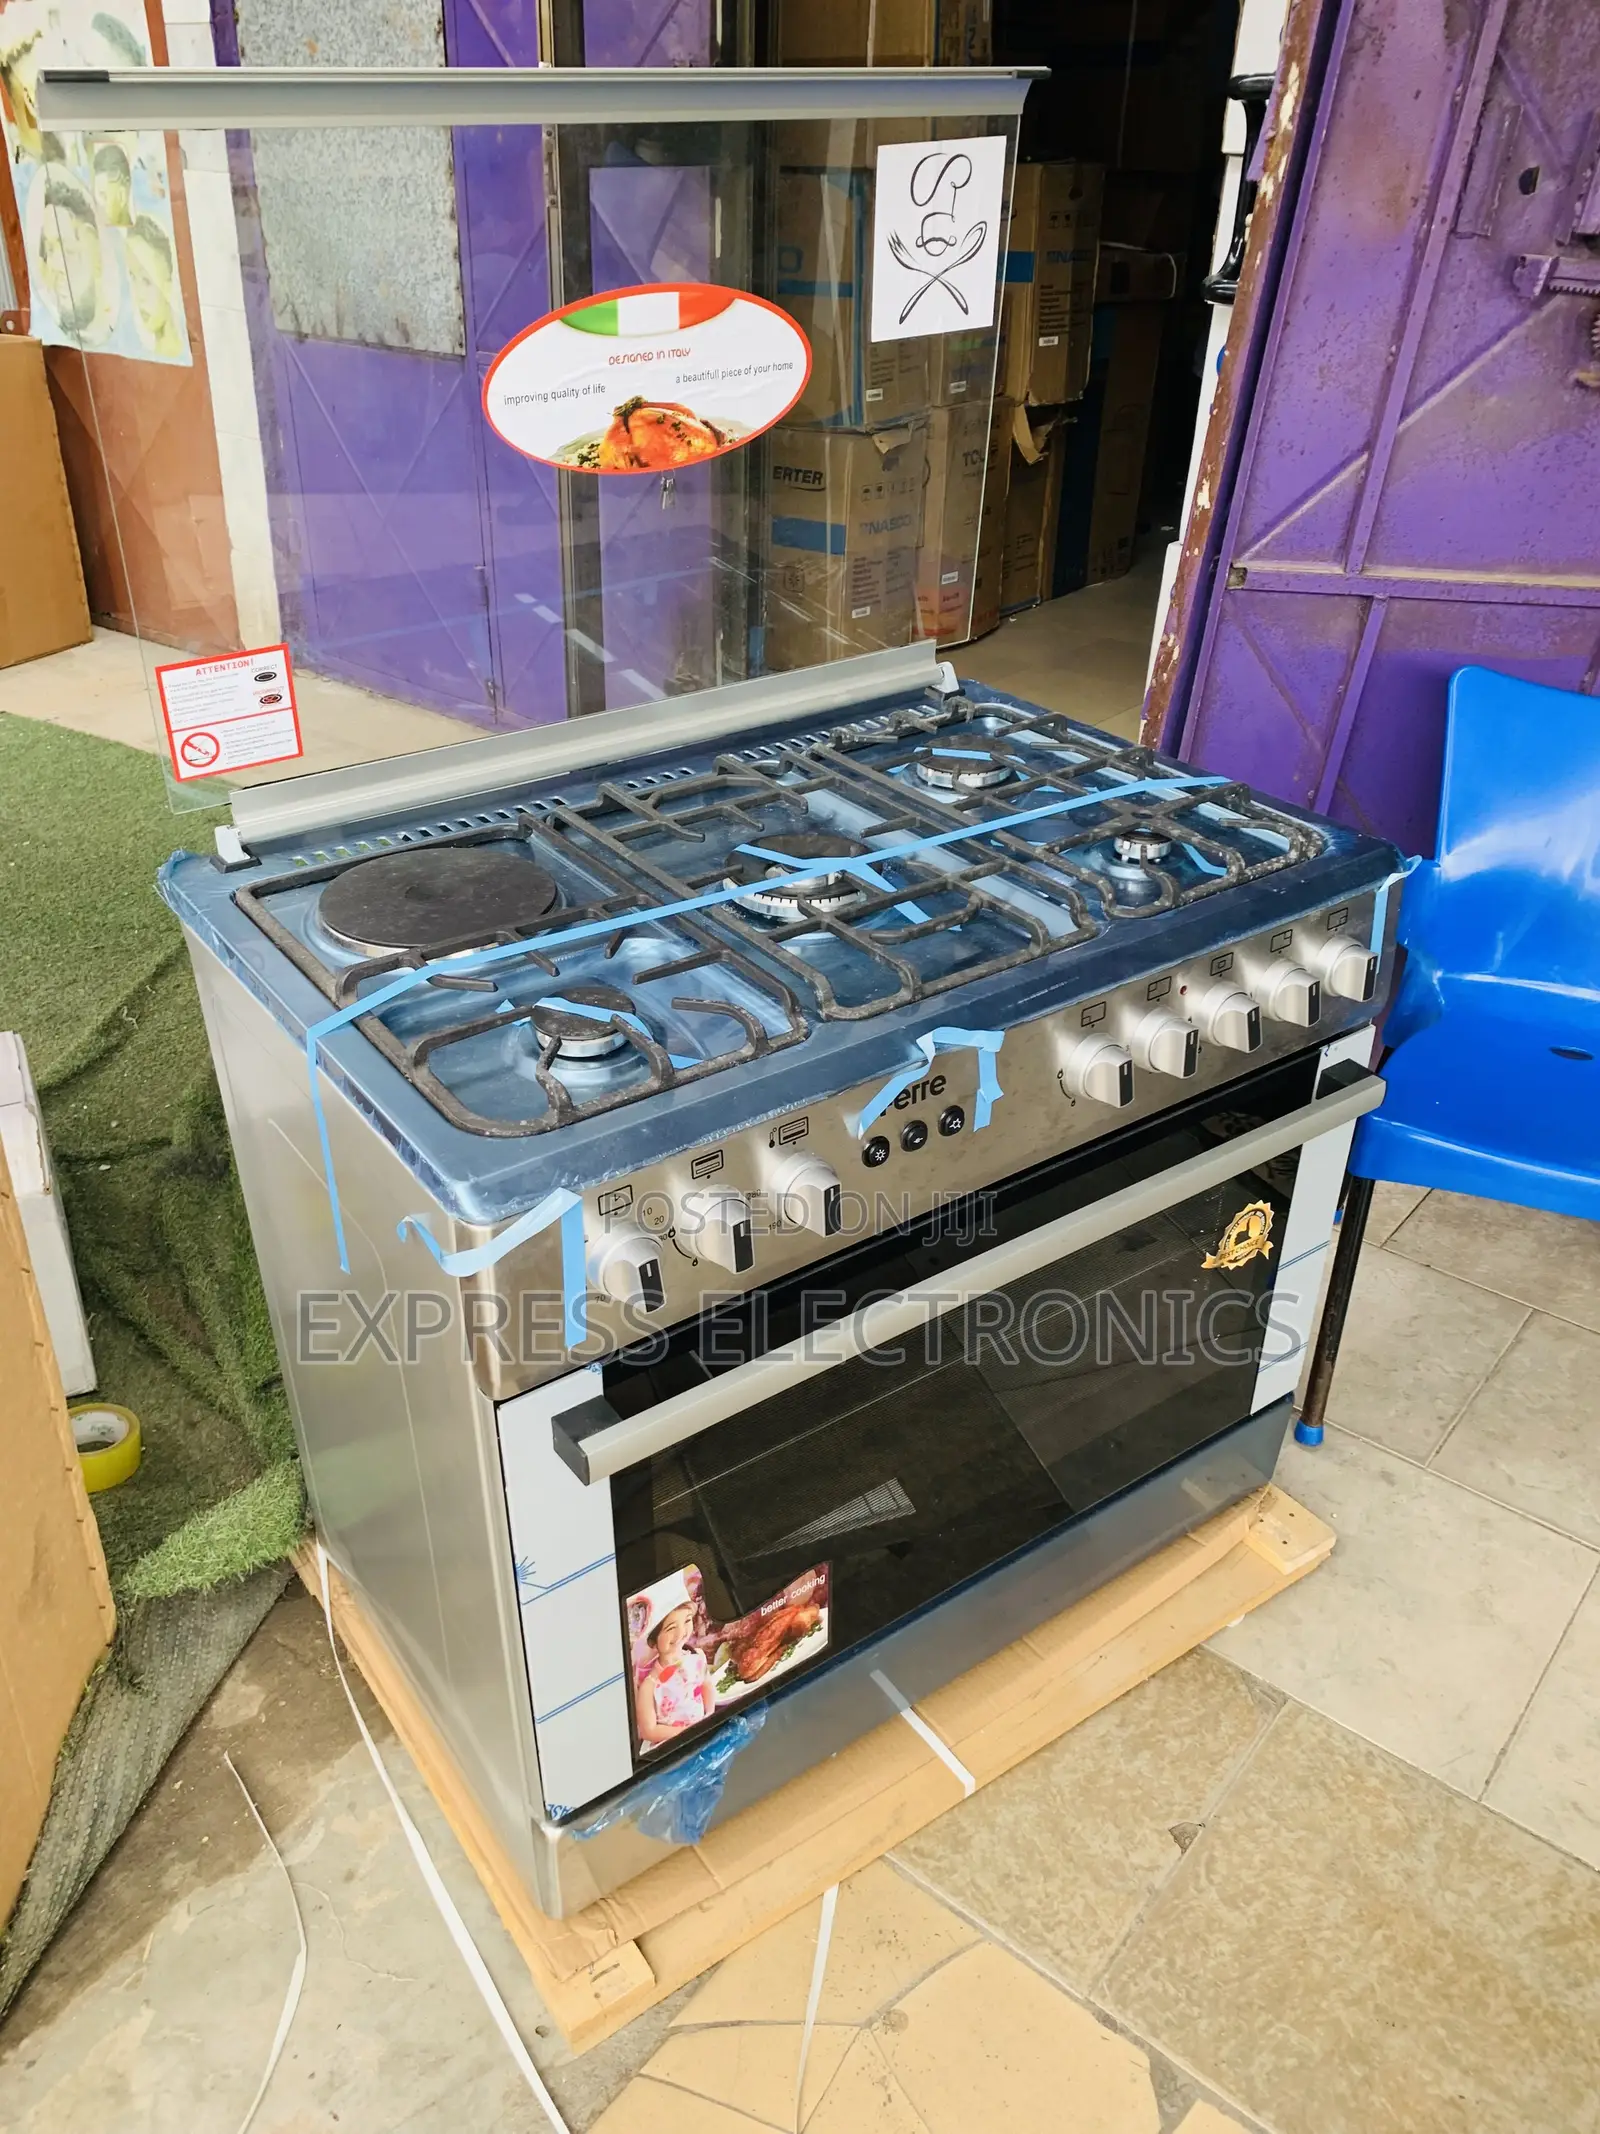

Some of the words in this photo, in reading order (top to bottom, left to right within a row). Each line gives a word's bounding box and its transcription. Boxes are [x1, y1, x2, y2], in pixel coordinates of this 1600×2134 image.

[608, 351, 654, 366] DESIGNED
[668, 347, 691, 358] ITALY
[675, 375, 681, 384] a
[682, 368, 720, 383] beautifull
[721, 367, 742, 381] piece
[744, 364, 752, 375] of
[753, 364, 771, 377] your
[772, 361, 794, 372] home
[503, 391, 549, 407] improving
[550, 387, 580, 402] quality
[581, 385, 592, 397] of
[593, 382, 606, 395] life
[196, 658, 255, 676] ATTENTION!
[642, 1206, 653, 1217] 10
[654, 1214, 665, 1226] 20
[760, 1595, 788, 1616] better
[790, 1574, 826, 1599] cooking
